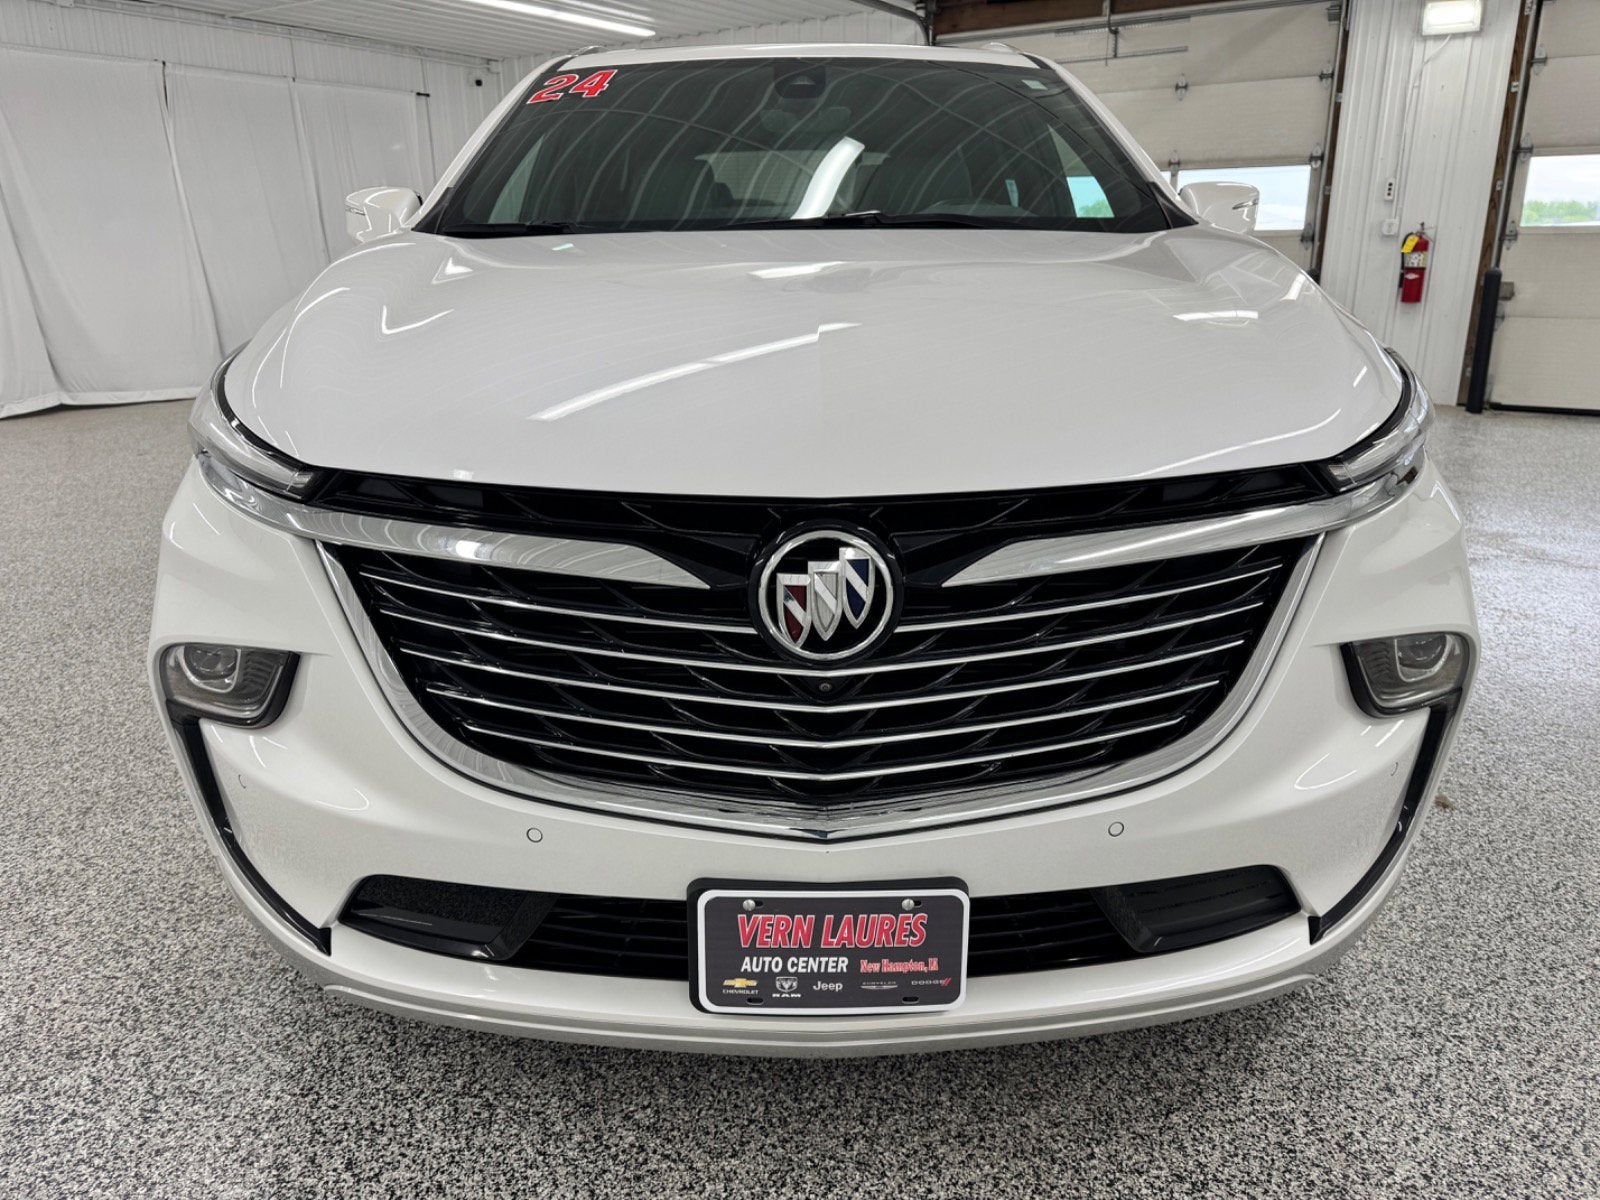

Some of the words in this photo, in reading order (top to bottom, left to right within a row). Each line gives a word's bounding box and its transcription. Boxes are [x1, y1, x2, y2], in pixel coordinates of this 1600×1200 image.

[526, 69, 618, 104] 24
[738, 914, 814, 948] VERN
[821, 913, 928, 948] LAURES
[741, 957, 783, 972] AUTO
[787, 957, 849, 973] CENTER
[860, 960, 880, 973] New
[881, 959, 928, 973] Hampton,
[812, 981, 843, 992] Jeep
